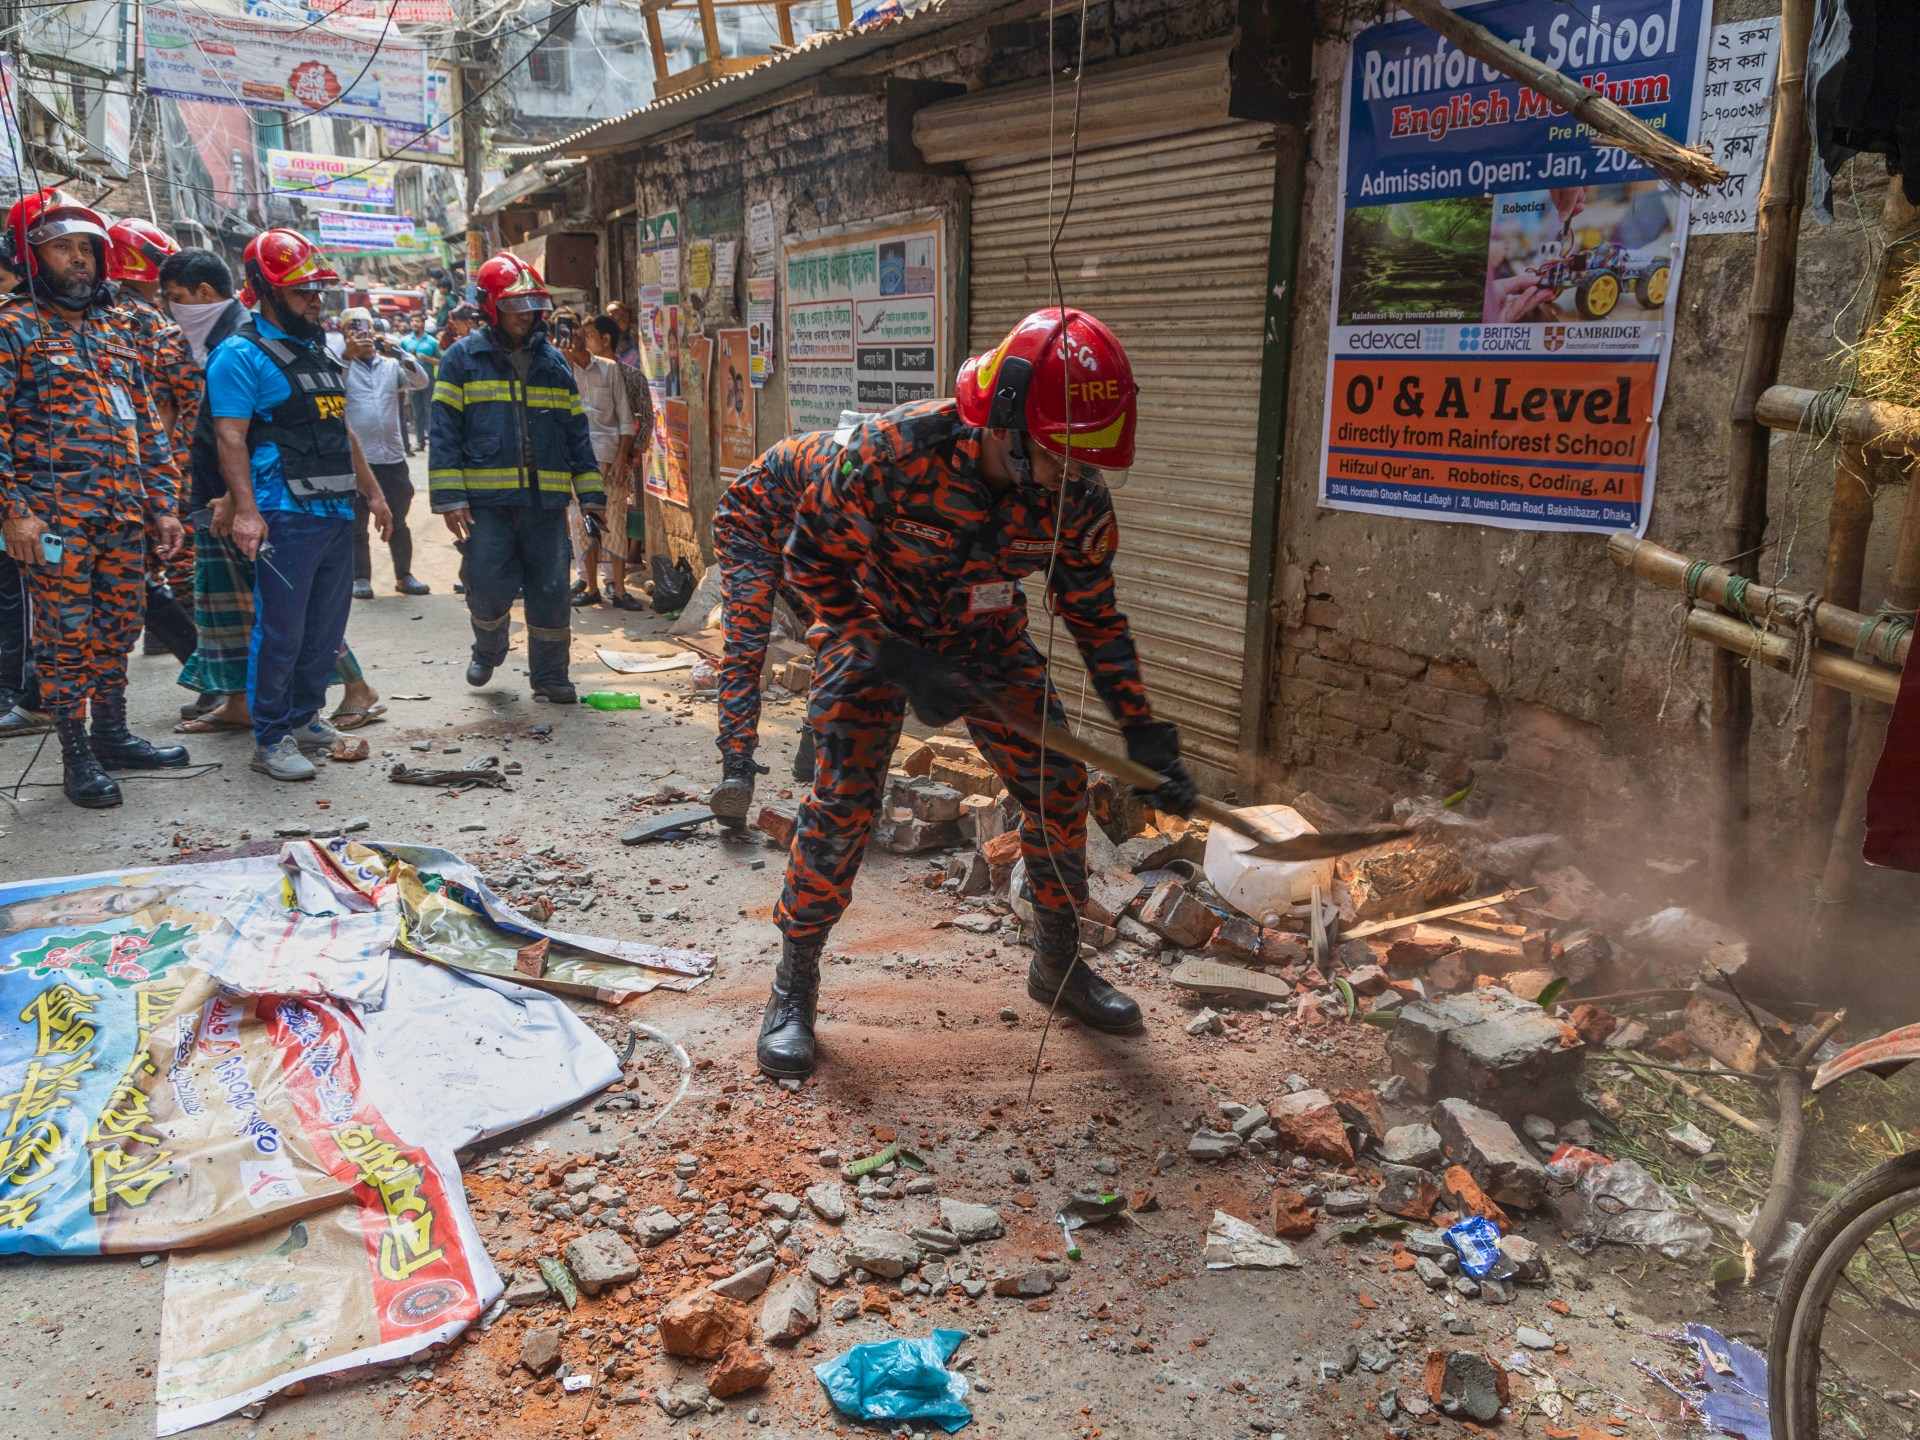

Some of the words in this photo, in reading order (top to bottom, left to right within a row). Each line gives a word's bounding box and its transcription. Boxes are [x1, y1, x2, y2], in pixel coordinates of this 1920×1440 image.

[1546, 0, 1680, 71] School
[1738, 27, 1774, 45] রুম
[1707, 55, 1733, 75] ইস
[1736, 52, 1768, 69] করা
[1733, 77, 1764, 96] হবে
[1390, 86, 1512, 142] English
[1549, 123, 1574, 141] Pre
[1723, 134, 1759, 160] রুম
[1360, 162, 1463, 197] Admission
[1468, 159, 1532, 190] Open:
[1538, 152, 1588, 182] Jan,
[1594, 147, 1653, 174] 202
[1502, 201, 1547, 215] Robotics
[1405, 310, 1435, 320] towards
[1436, 310, 1448, 320] the
[1349, 328, 1421, 350] edexcel
[1484, 326, 1531, 339] BRITISH
[1566, 325, 1641, 340] CAMBRIDGE
[1483, 339, 1532, 351] COUNCIL
[1565, 341, 1600, 350] International
[1601, 341, 1640, 351] Examinations
[1068, 379, 1120, 403] FIRE
[1393, 375, 1424, 418] &
[1490, 376, 1632, 425] Level
[314, 395, 346, 420] FIR
[1338, 422, 1400, 448] directly
[1403, 426, 1444, 447] from
[1450, 428, 1551, 453] Rainforest
[1555, 433, 1636, 458] School
[1339, 458, 1378, 476] Hifzul
[1448, 466, 1524, 491] Robotics,
[1529, 471, 1599, 497] Coding,
[1602, 477, 1624, 495] AI
[1350, 484, 1379, 499] Horonath
[1380, 487, 1402, 501] Ghosh
[1403, 489, 1423, 504] Road,
[1424, 491, 1452, 508] Lalbagh
[1461, 496, 1472, 510] 20,
[1473, 496, 1499, 511] Umesh
[1500, 499, 1521, 513] Dutta
[1522, 500, 1546, 516] Road,
[1547, 503, 1601, 521] Bakshibazar,
[1603, 507, 1632, 522] Dhaka
[207, 997, 232, 1036] নগদ
